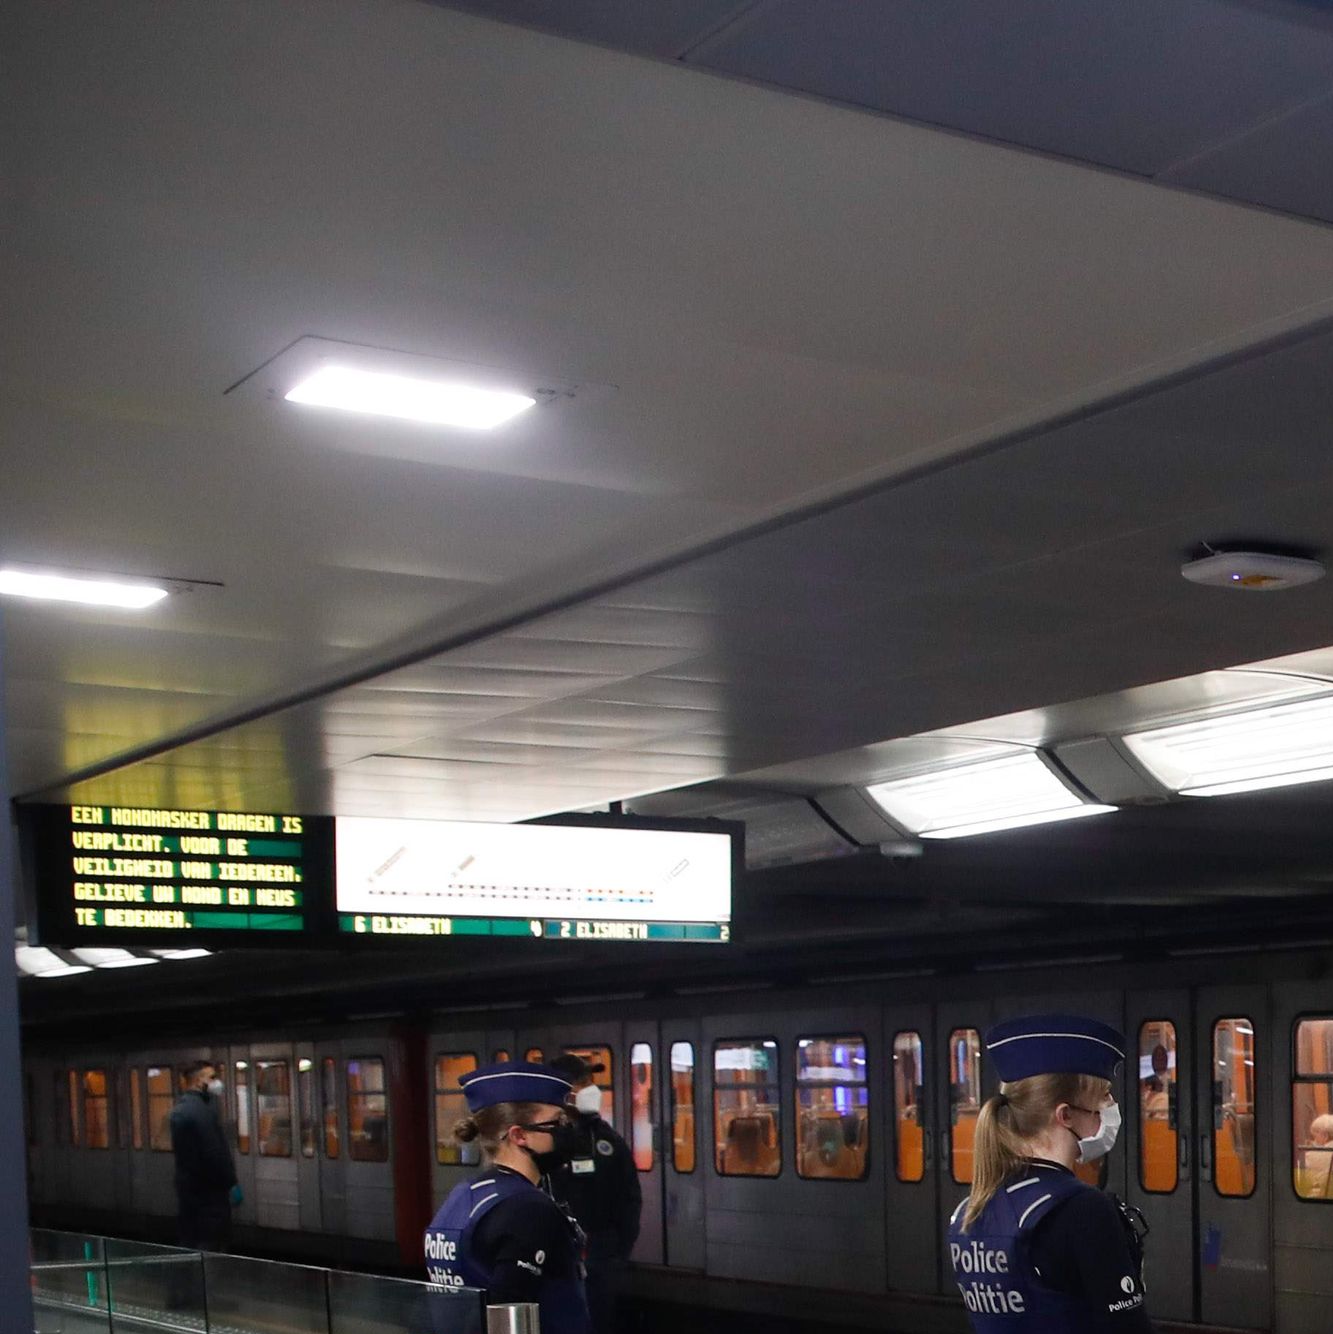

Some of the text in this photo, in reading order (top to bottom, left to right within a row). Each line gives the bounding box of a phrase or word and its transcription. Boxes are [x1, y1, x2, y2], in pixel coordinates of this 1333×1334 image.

[71, 806, 103, 824] EEN
[217, 813, 275, 832] DRAGEN
[282, 816, 303, 834] IS
[180, 837, 220, 855] VOOR
[227, 839, 248, 856] DE
[73, 858, 173, 878] VEILIGHEID
[181, 862, 211, 879] VAN
[74, 883, 145, 902] GELIEVE
[182, 887, 221, 904] MOND
[229, 888, 249, 905] EN
[256, 889, 295, 906] NEUS
[76, 908, 97, 925] TE
[372, 916, 452, 935] ELISABETH
[560, 921, 730, 940] 2 ELISABETH 2
[424, 1232, 456, 1261] Police
[950, 1240, 1008, 1273] Police
[1108, 1299, 1133, 1313] Police
